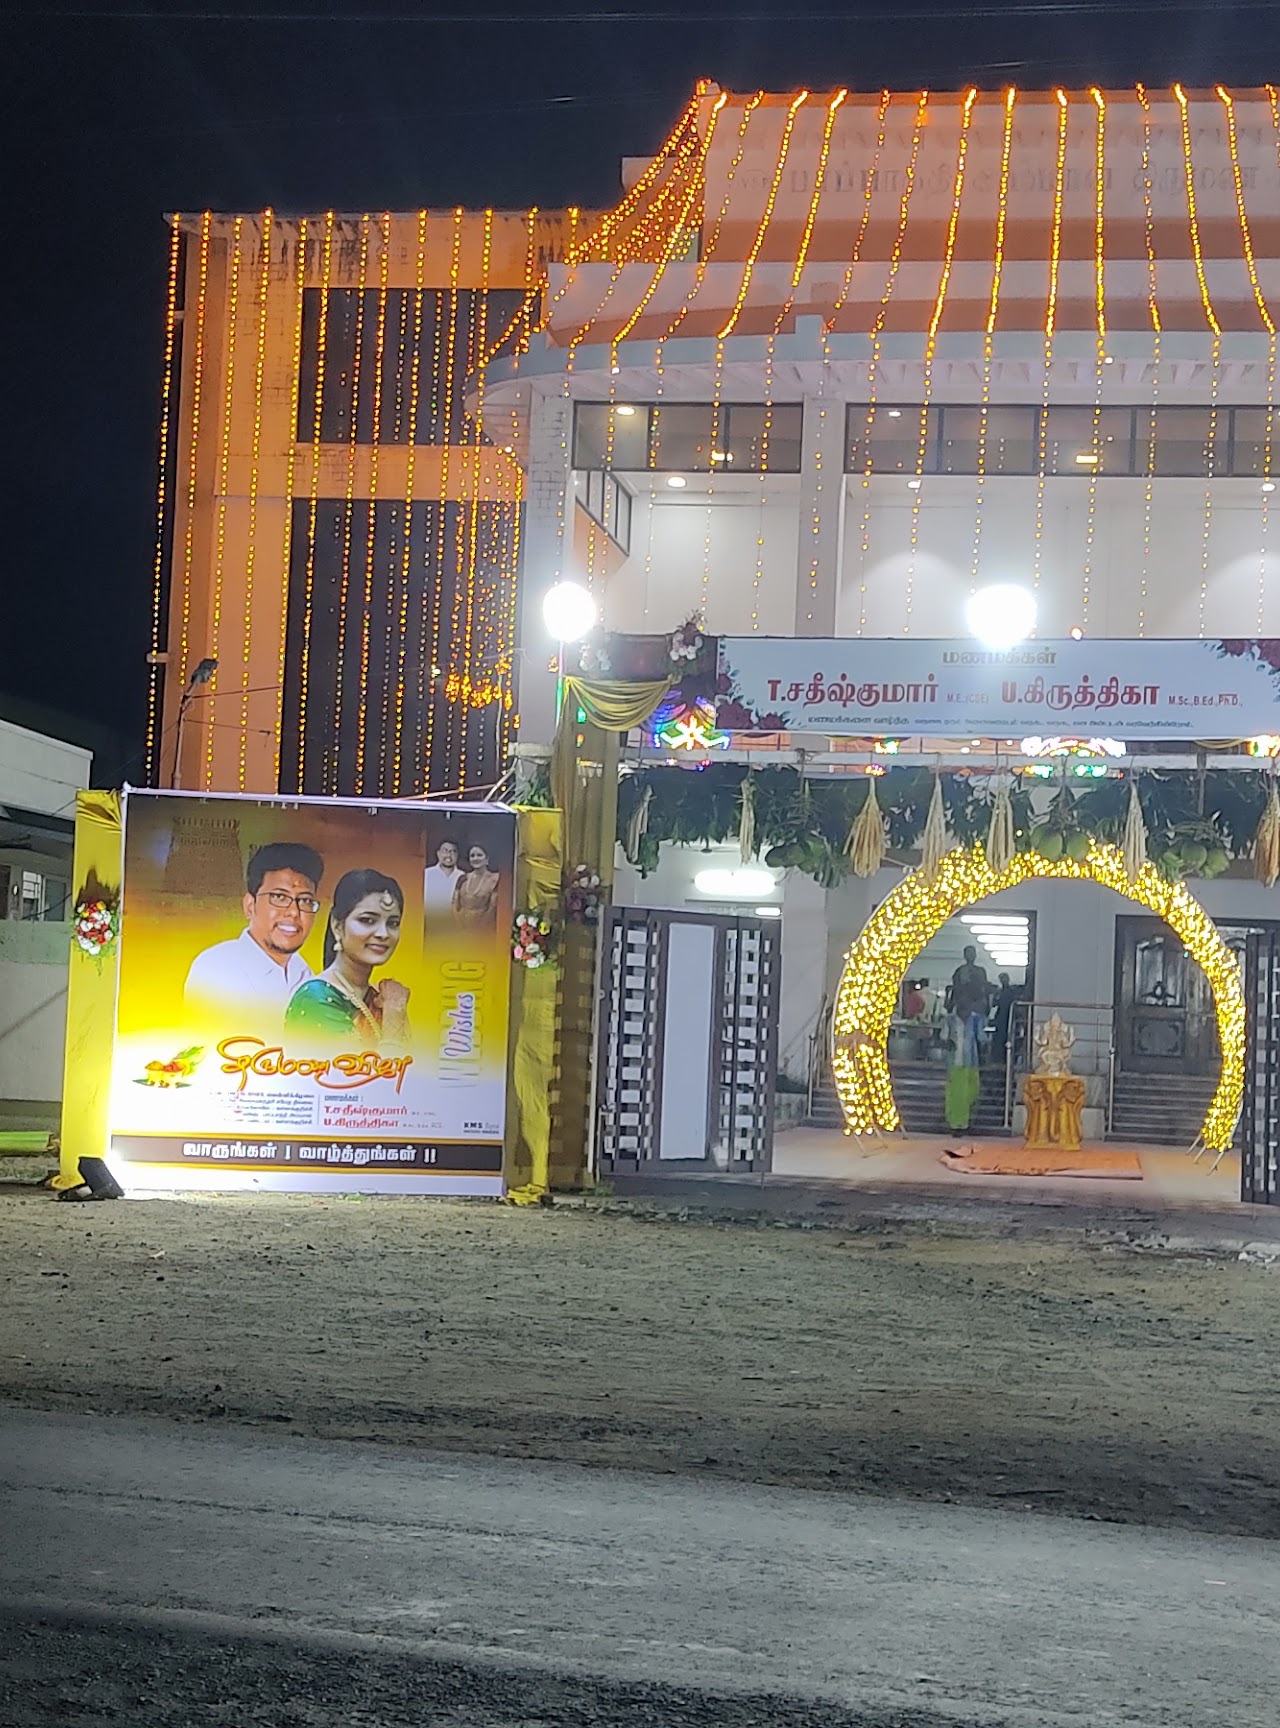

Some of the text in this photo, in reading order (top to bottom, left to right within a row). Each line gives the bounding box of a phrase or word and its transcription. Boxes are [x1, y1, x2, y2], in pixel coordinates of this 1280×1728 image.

[942, 646, 1057, 665] மணமக்கள்
[767, 671, 939, 709] T.சதீஷ்குமார்
[443, 993, 475, 1058] Wishes
[216, 1035, 414, 1095] திருமண விழா
[182, 1141, 278, 1160] வாருங்கள்
[298, 1143, 418, 1165] வாழ்த்துங்கள்
